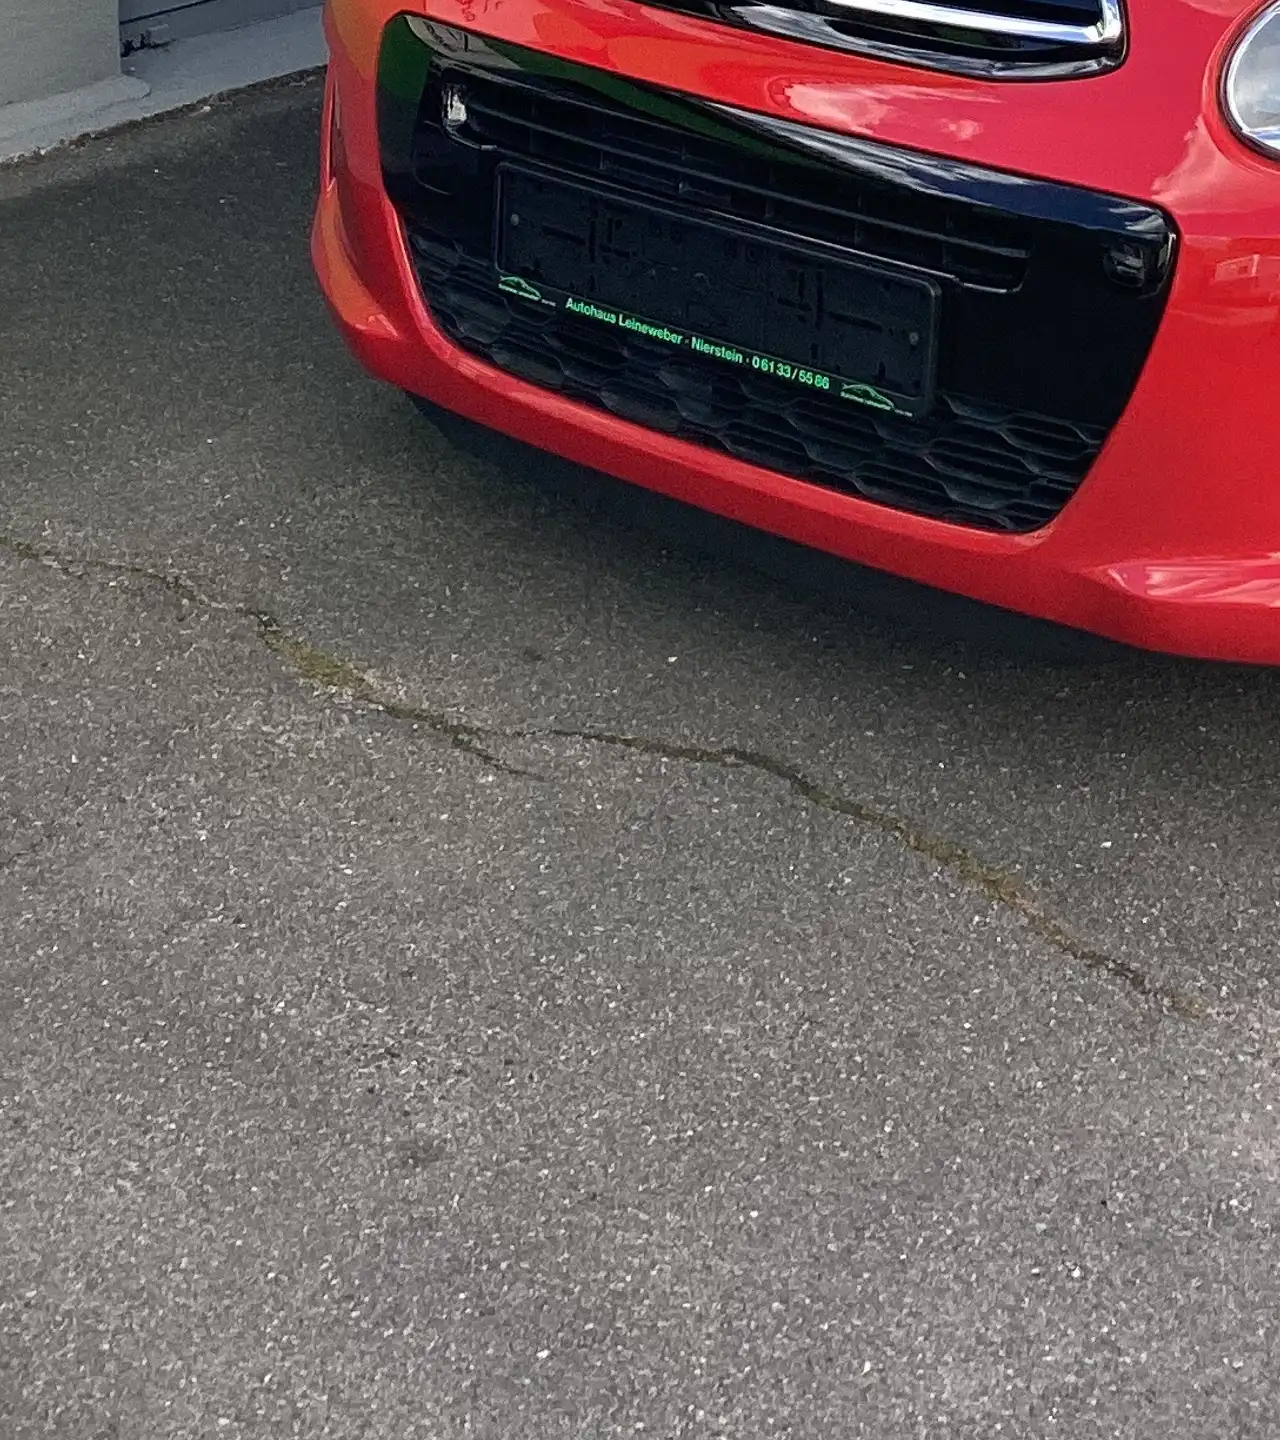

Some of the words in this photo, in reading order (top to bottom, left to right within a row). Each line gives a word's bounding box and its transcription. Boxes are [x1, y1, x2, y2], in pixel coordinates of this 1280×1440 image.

[565, 297, 617, 324] Autohaus
[618, 313, 683, 345] Leineweber
[690, 335, 743, 364] Nierstein
